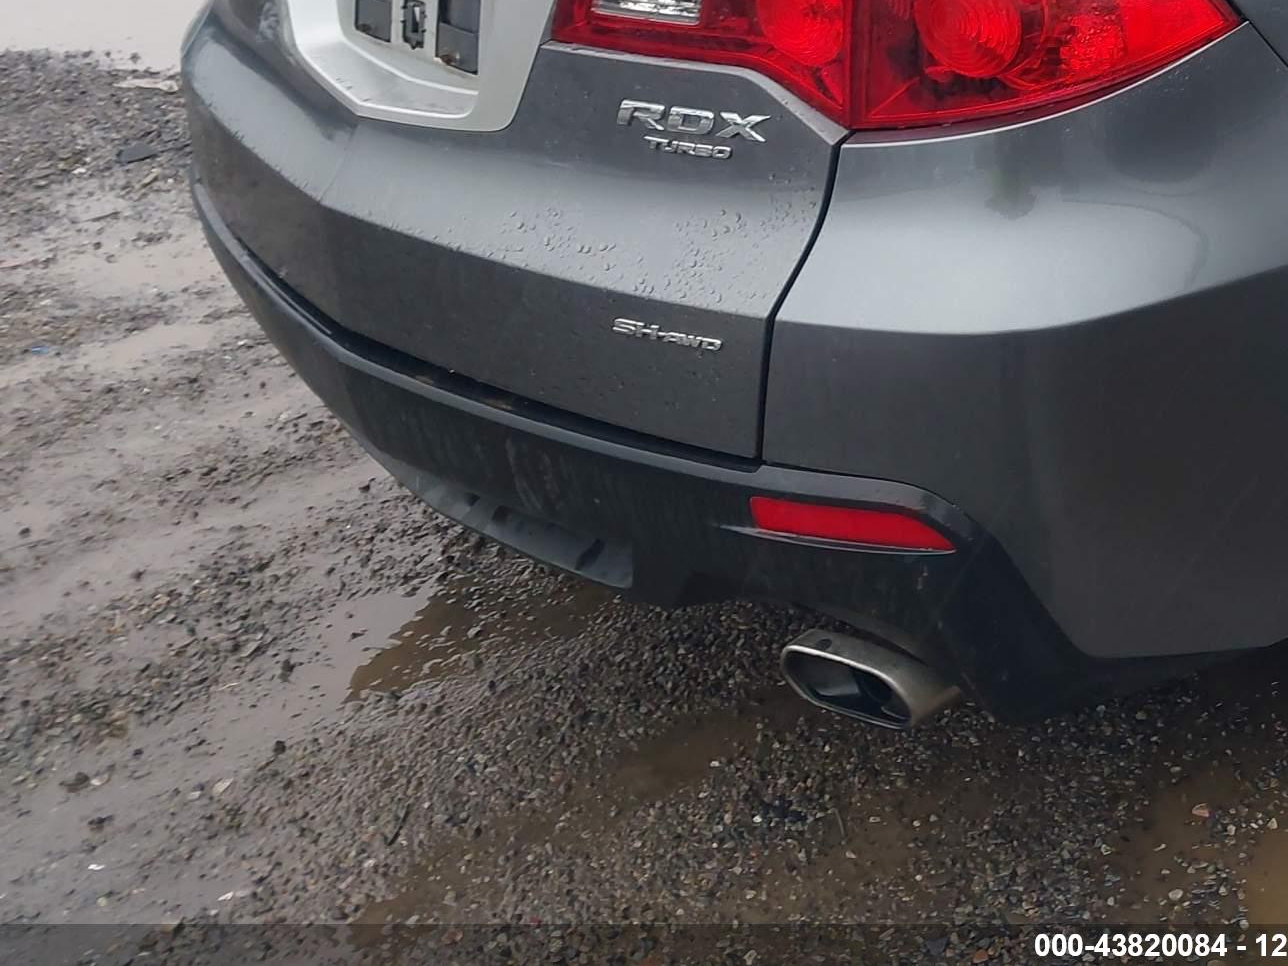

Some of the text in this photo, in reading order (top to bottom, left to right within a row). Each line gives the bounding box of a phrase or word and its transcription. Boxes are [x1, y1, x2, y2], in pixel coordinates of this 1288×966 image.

[616, 99, 772, 143] RDX
[643, 135, 733, 160] TURBO
[612, 318, 722, 351] SH-AWD
